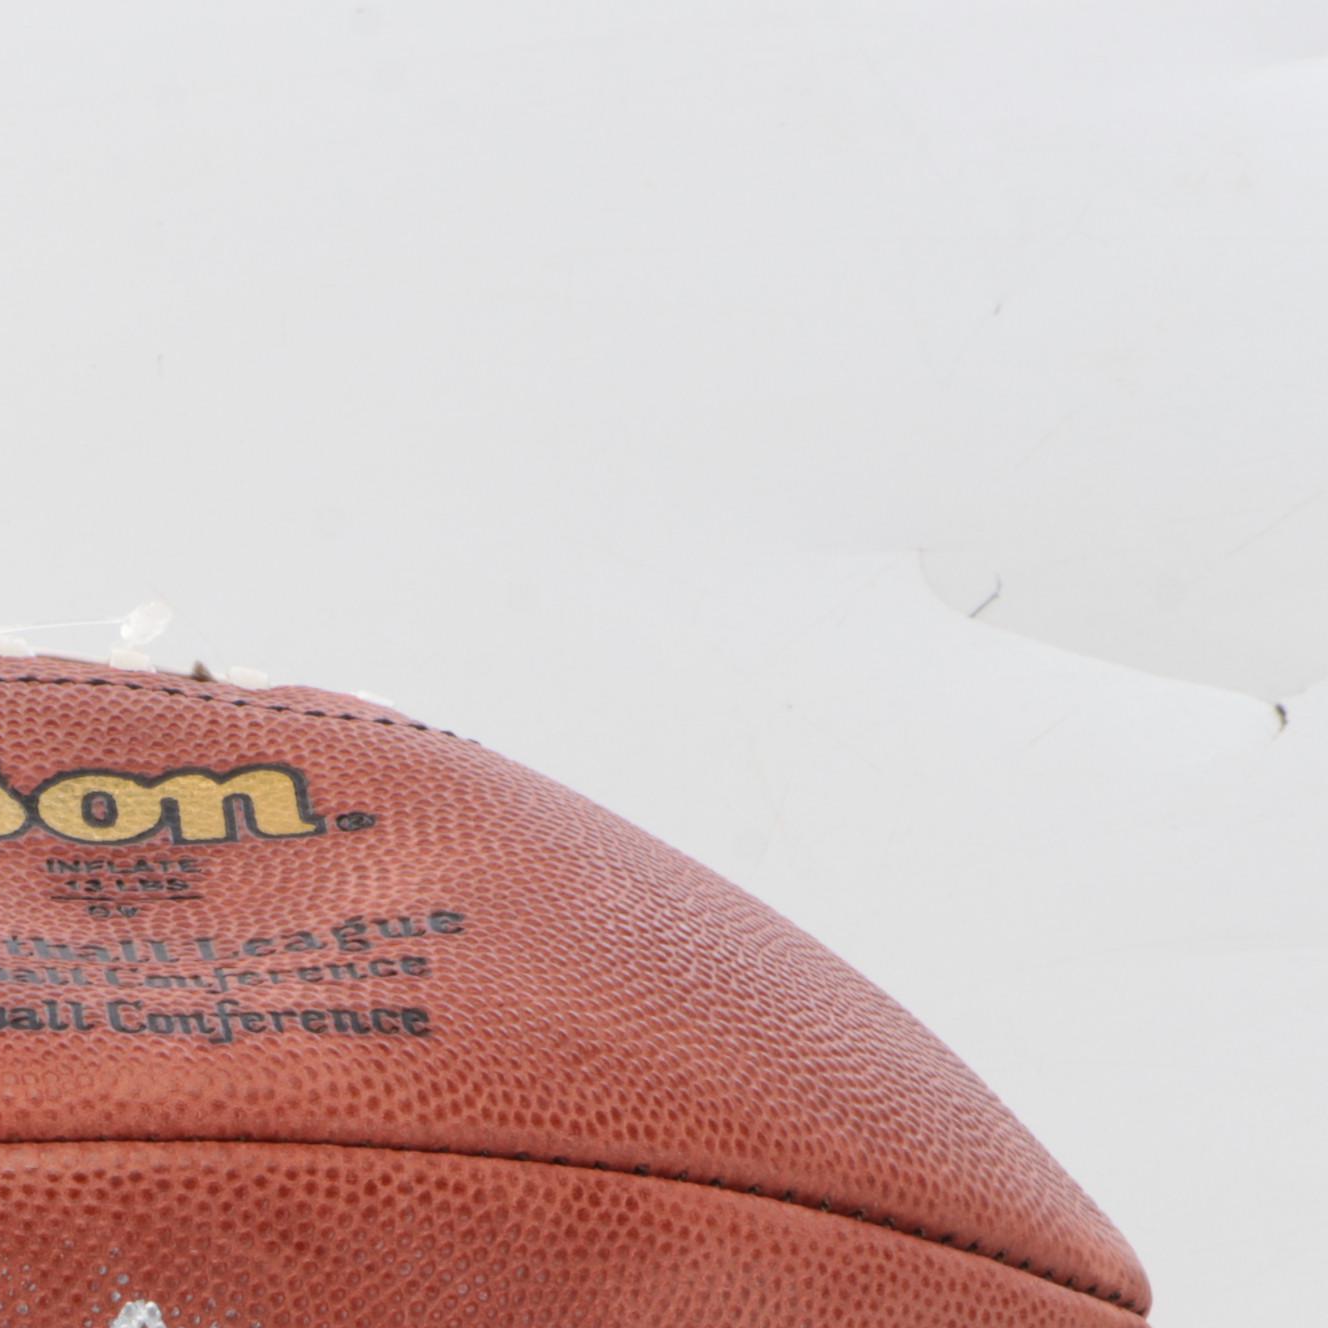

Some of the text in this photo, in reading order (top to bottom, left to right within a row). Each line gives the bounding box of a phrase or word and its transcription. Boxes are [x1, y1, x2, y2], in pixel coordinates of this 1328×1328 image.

[45, 858, 203, 874] INFLATE
[194, 910, 465, 962] League
[103, 954, 429, 994] Conference
[105, 999, 431, 1044] Conference
